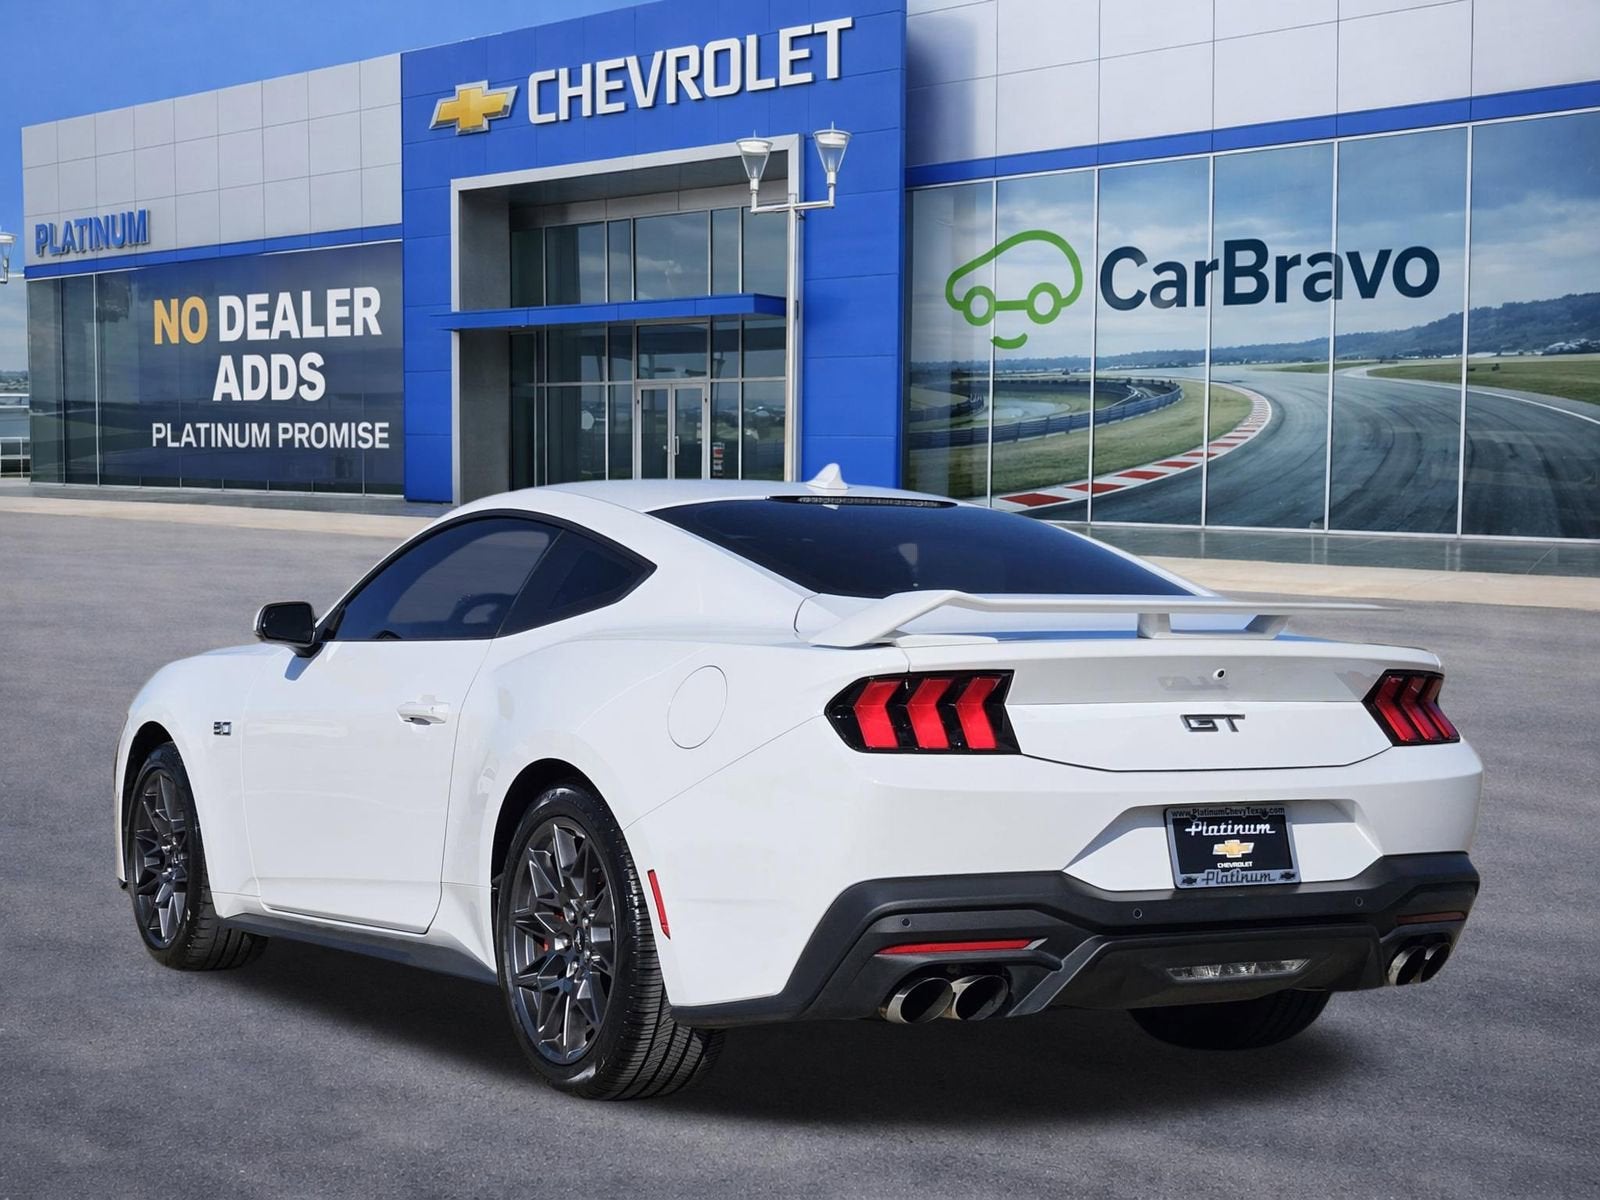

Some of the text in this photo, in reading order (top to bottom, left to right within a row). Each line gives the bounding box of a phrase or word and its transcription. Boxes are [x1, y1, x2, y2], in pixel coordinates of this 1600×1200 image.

[528, 17, 853, 125] CHEVROLET
[35, 209, 150, 257] PLATINUM
[1100, 238, 1440, 311] CarBravo
[153, 286, 382, 345] NO DEALER
[212, 352, 326, 402] ADDS
[151, 421, 390, 449] PLATINUM PROMISE
[1180, 713, 1246, 733] GT
[1185, 821, 1276, 836] Platinum
[1202, 870, 1276, 885] Platinum
